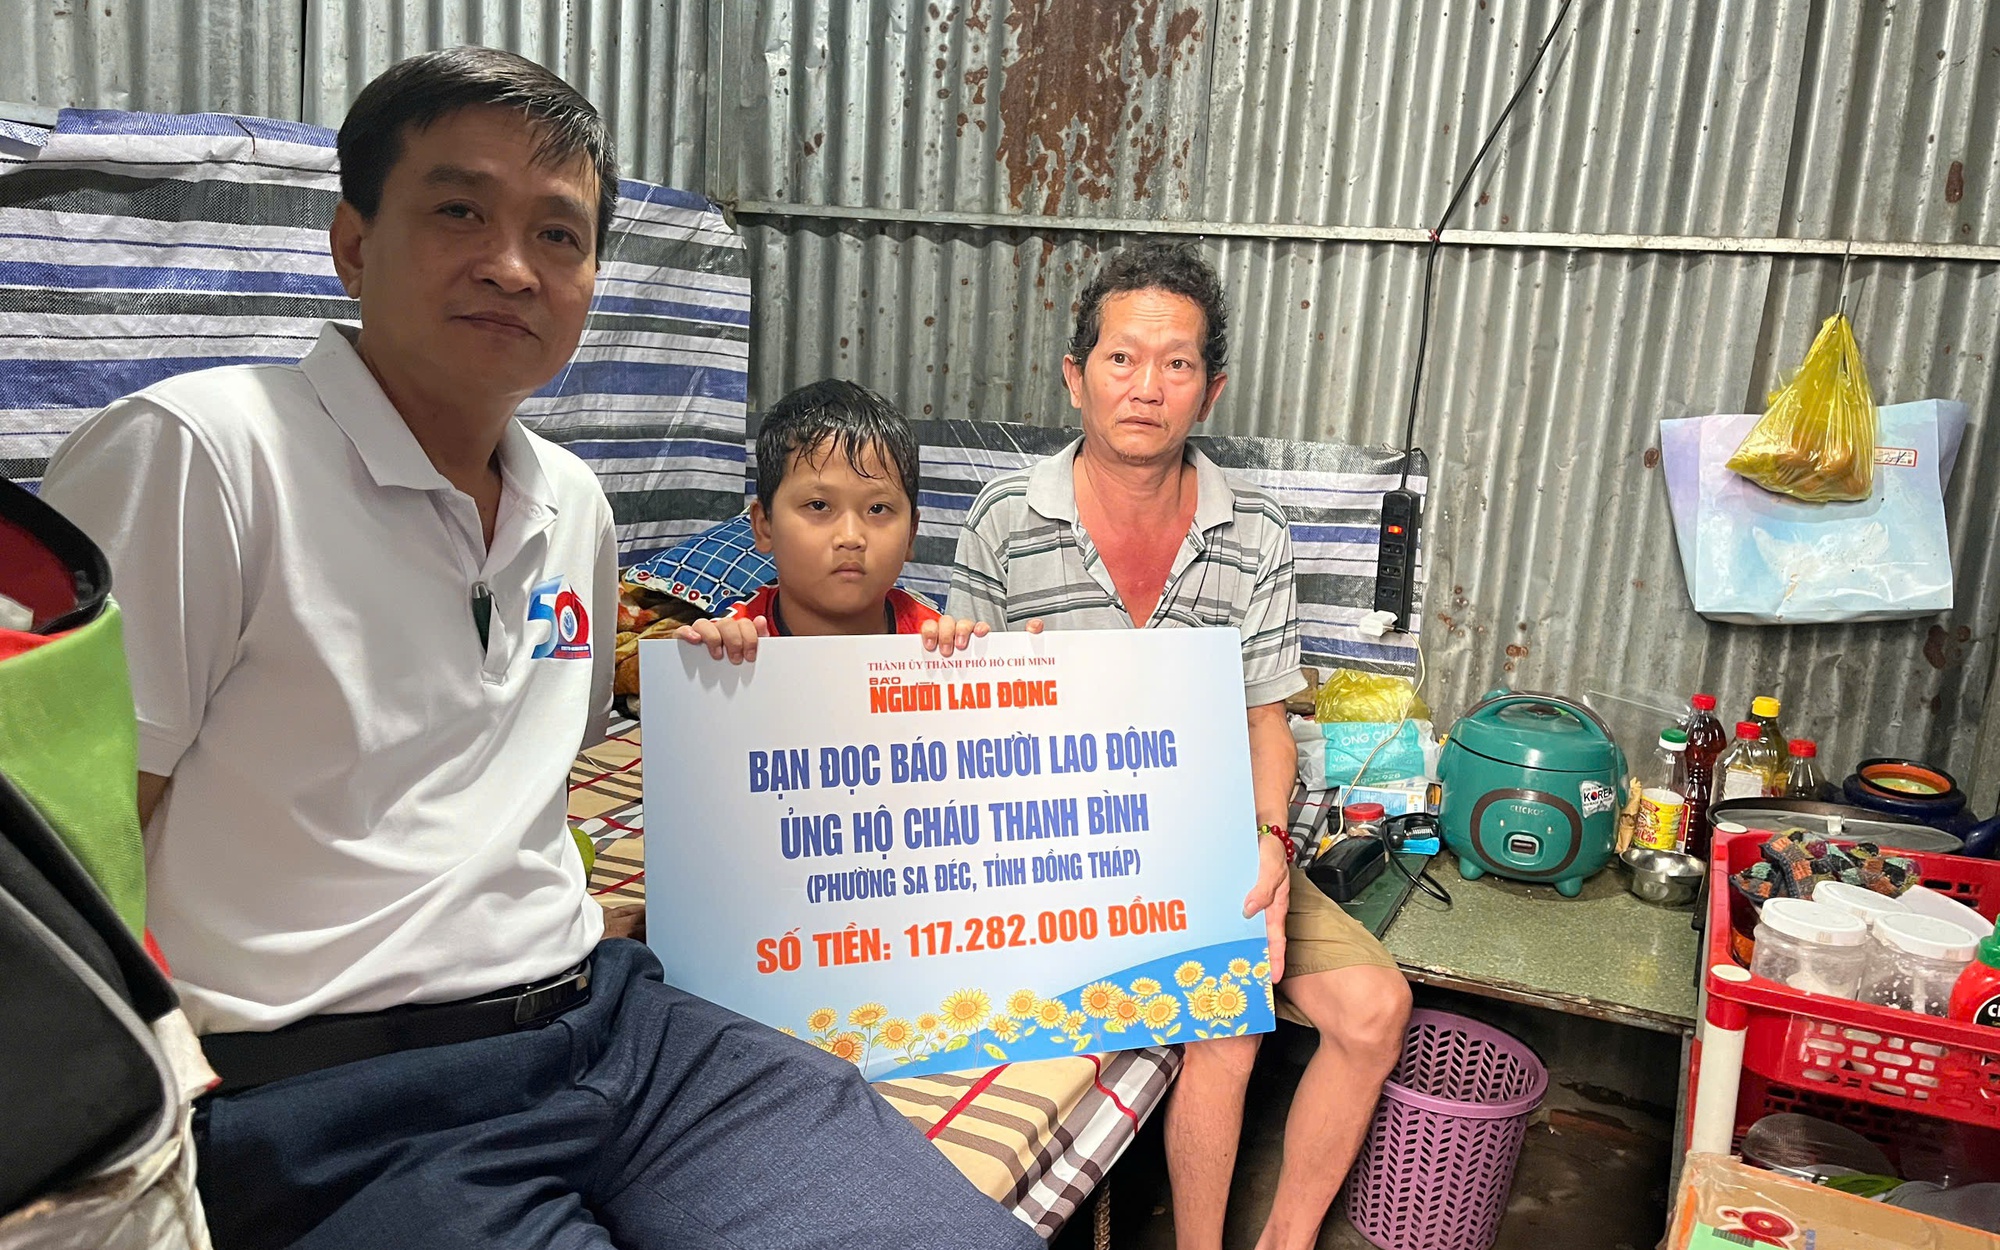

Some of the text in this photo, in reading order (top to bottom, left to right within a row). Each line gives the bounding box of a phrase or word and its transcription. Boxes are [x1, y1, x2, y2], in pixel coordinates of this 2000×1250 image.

[867, 661, 905, 671] THÀNH
[926, 659, 962, 669] THÀNH
[989, 656, 1005, 667] HỒ
[1007, 656, 1025, 667] CHÍ
[1028, 656, 1056, 666] MINH
[870, 679, 1057, 713] NGƯỜI LAO ĐỘNG
[749, 726, 1177, 800] BẠN ĐỌC BÁO NGƯỜI LAO ĐỘNG
[1583, 787, 1613, 802] KOREA
[780, 789, 1149, 860] ỦNG HỘ CHÁU THANH BÌNH
[806, 846, 1141, 904] (PHƯỜNG SA ĐÉC, TỈNH ĐỒNG THÁP)
[756, 895, 1187, 974] SỐ TIỀN: 117.282.000 ĐỒNG
